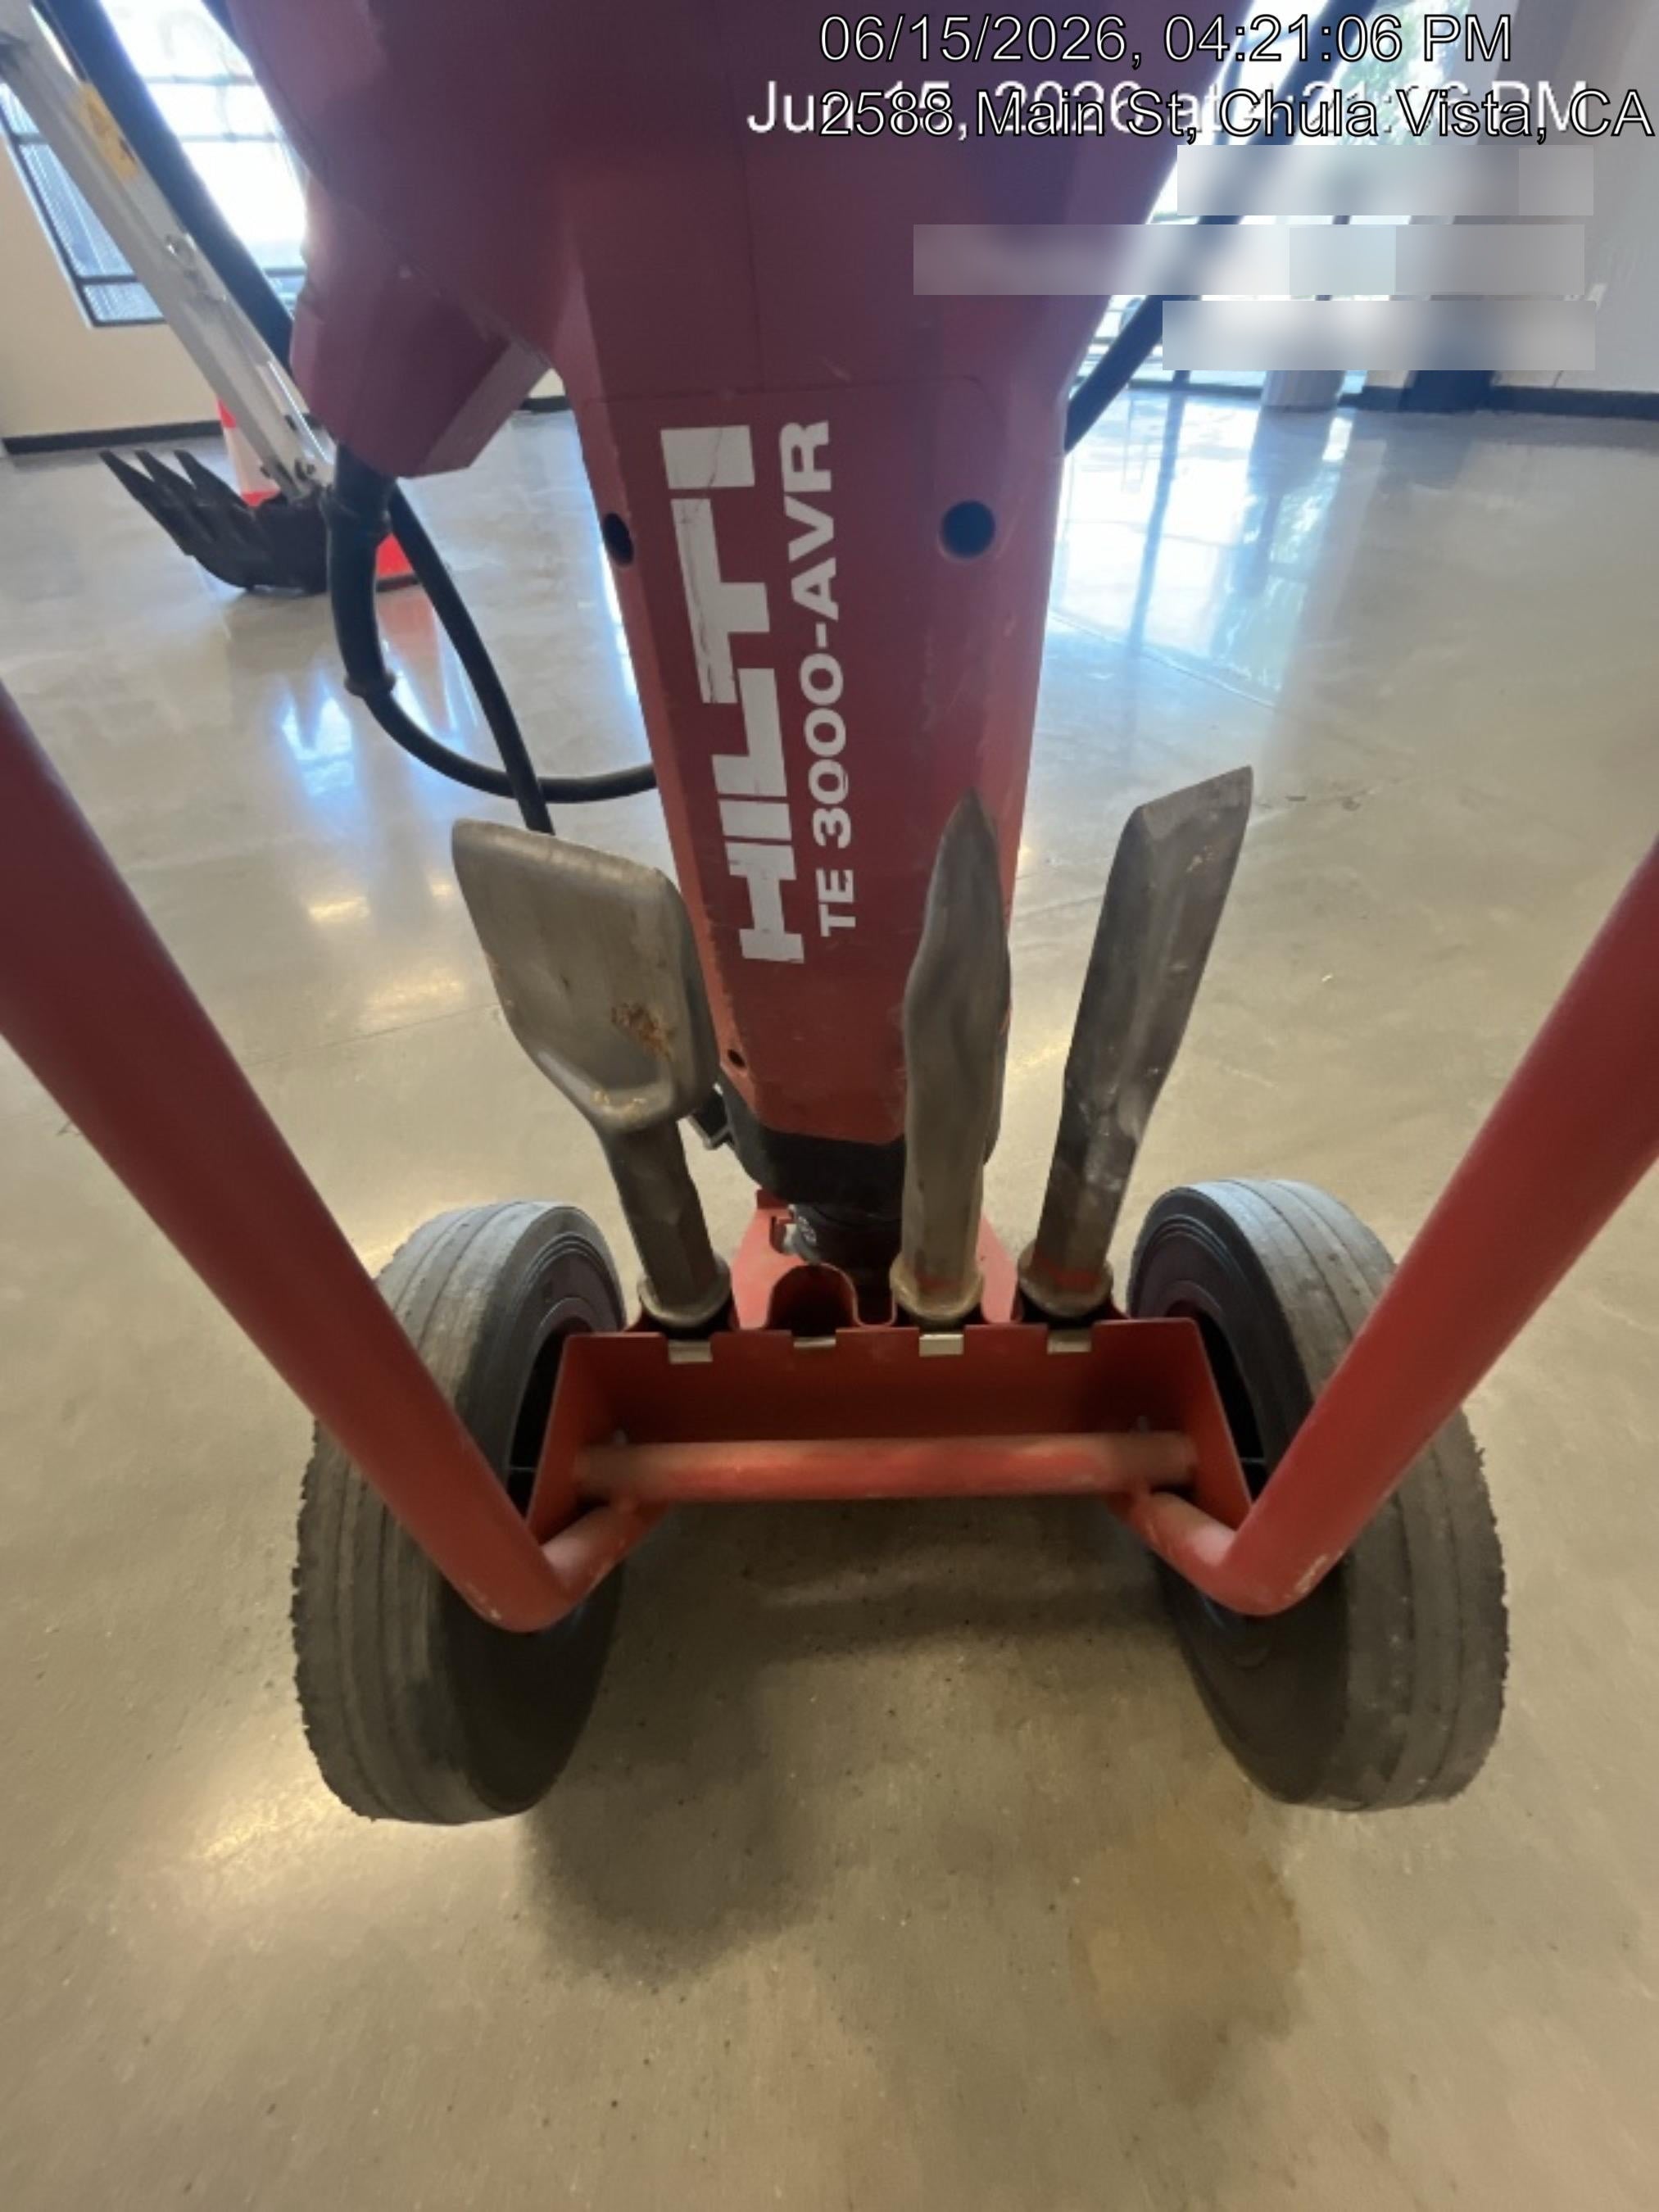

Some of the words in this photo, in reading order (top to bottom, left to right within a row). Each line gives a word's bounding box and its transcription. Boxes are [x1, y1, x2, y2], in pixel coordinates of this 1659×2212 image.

[660, 425, 805, 963] HILTI
[778, 420, 852, 850] 3000-AVR
[815, 867, 855, 936] TE
